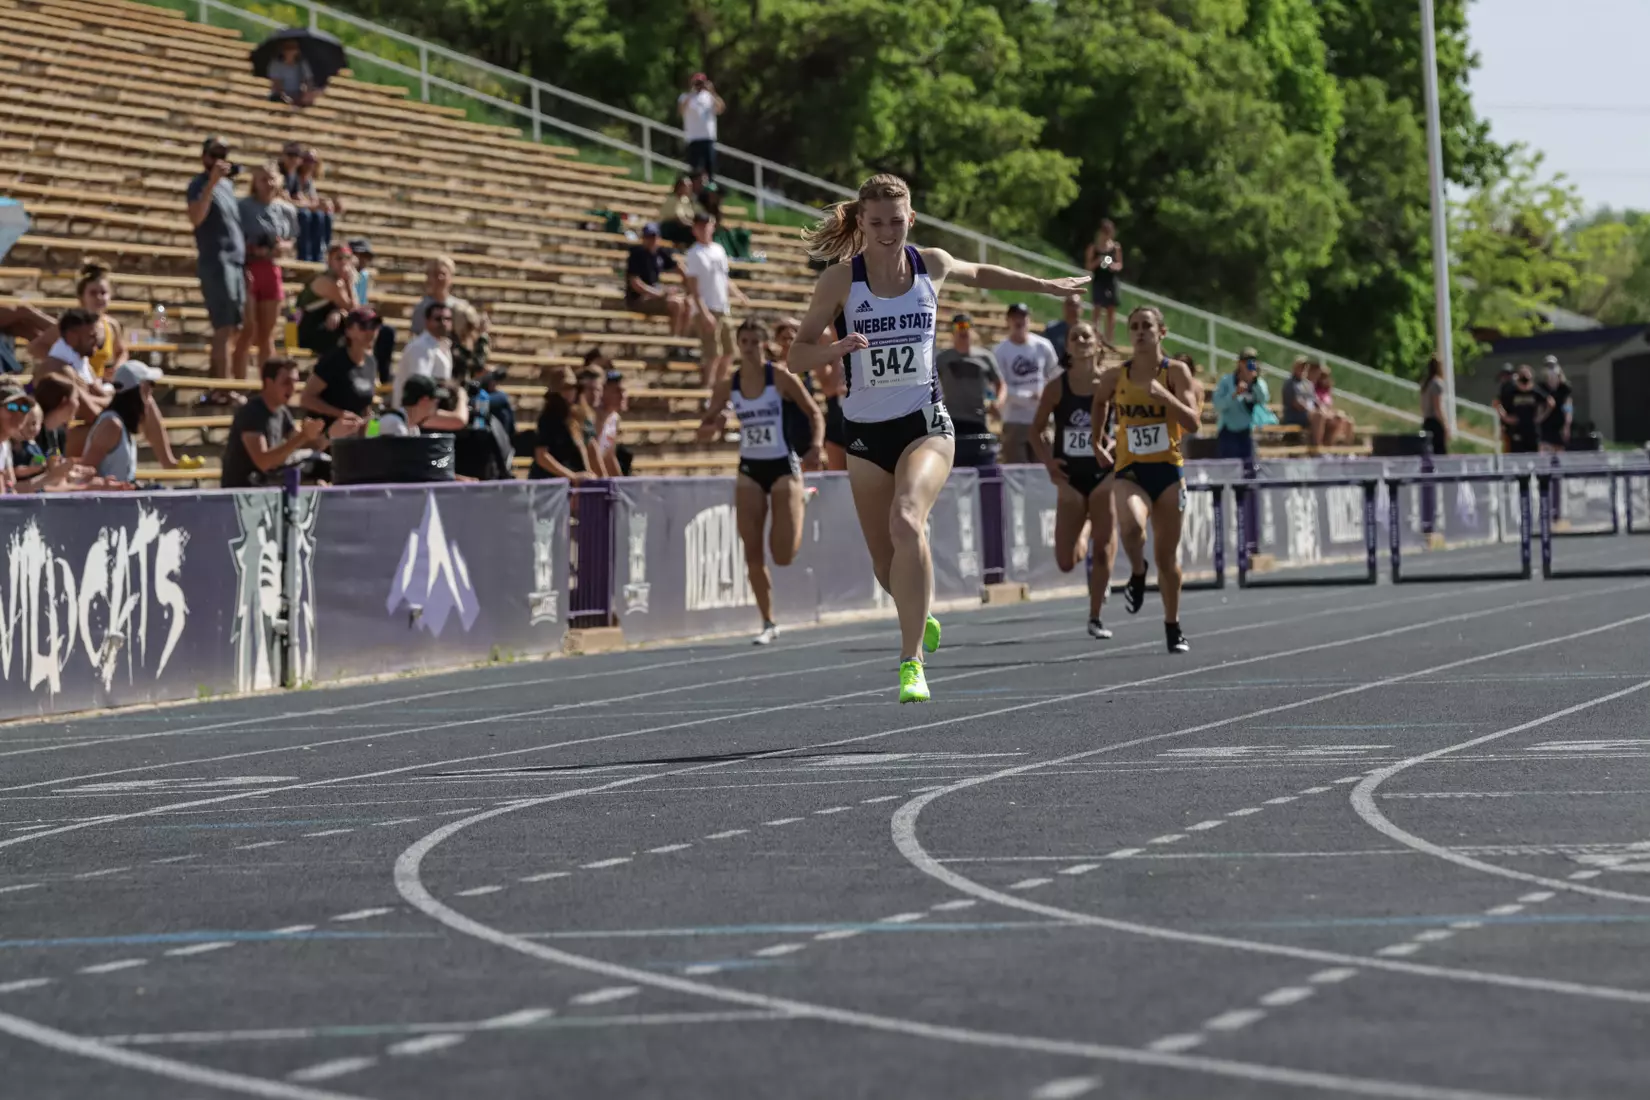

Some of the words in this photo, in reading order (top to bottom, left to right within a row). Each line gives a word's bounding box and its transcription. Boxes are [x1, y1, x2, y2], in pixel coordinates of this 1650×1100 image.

[853, 316, 896, 335] WEBER
[899, 312, 933, 330] STATE
[870, 345, 917, 377] 542
[1120, 404, 1166, 418] NAU
[1132, 426, 1160, 447] 357
